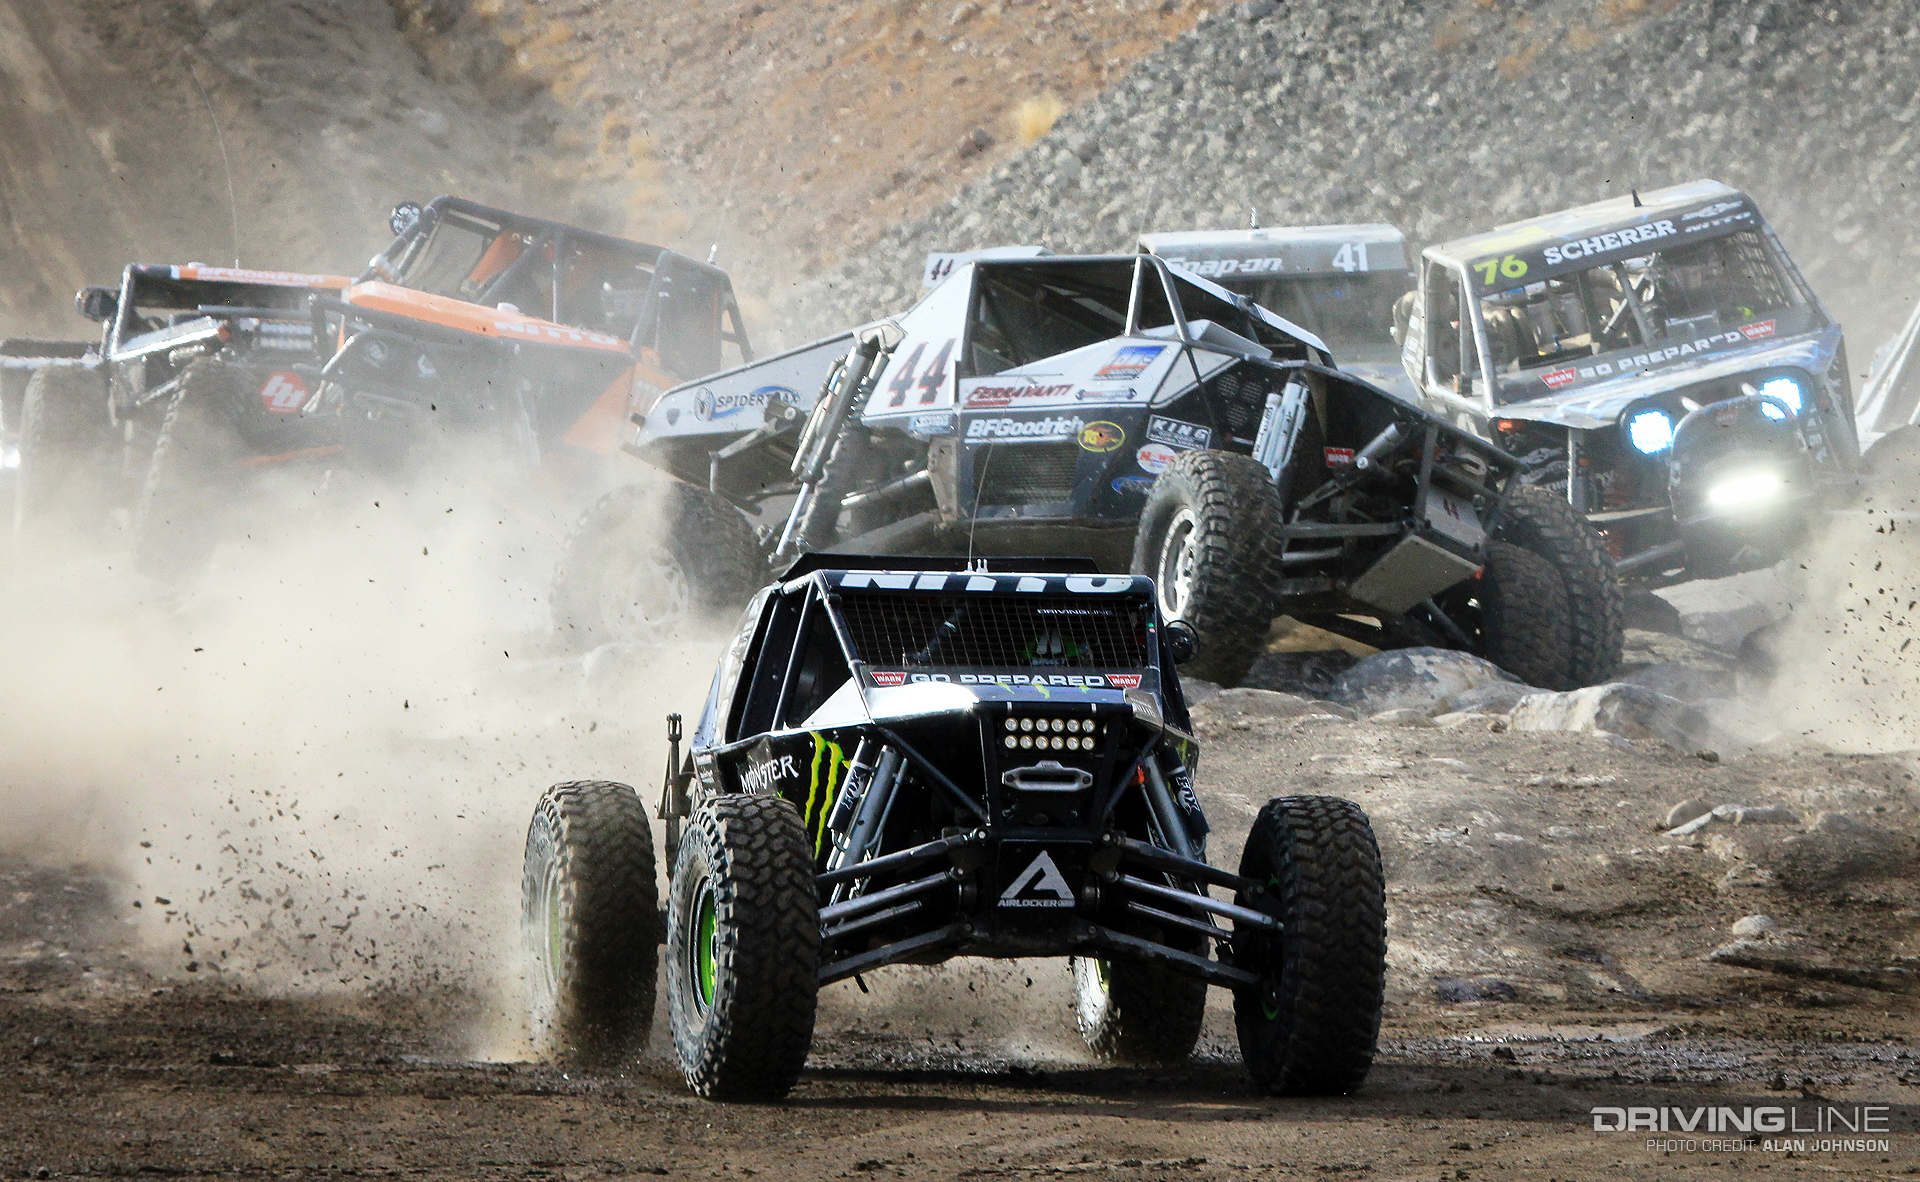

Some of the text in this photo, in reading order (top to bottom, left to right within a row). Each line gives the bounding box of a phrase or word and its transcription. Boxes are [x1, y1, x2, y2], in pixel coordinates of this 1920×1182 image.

[1543, 219, 1677, 265] SCHERER
[1332, 243, 1368, 272] 41
[1472, 254, 1528, 285] 76
[493, 320, 618, 345] NITTO
[1746, 324, 1772, 336] WARN
[887, 338, 957, 407] 44
[1546, 373, 1572, 385] WARN
[966, 415, 1086, 438] BFGoodrich
[1153, 419, 1208, 438] KING
[877, 674, 902, 683] WARN
[911, 673, 1105, 687] GO PREPARED
[1112, 677, 1137, 686] WARN
[740, 754, 799, 796] MONSTER
[840, 767, 866, 812] FOX
[1176, 775, 1201, 816] FOX
